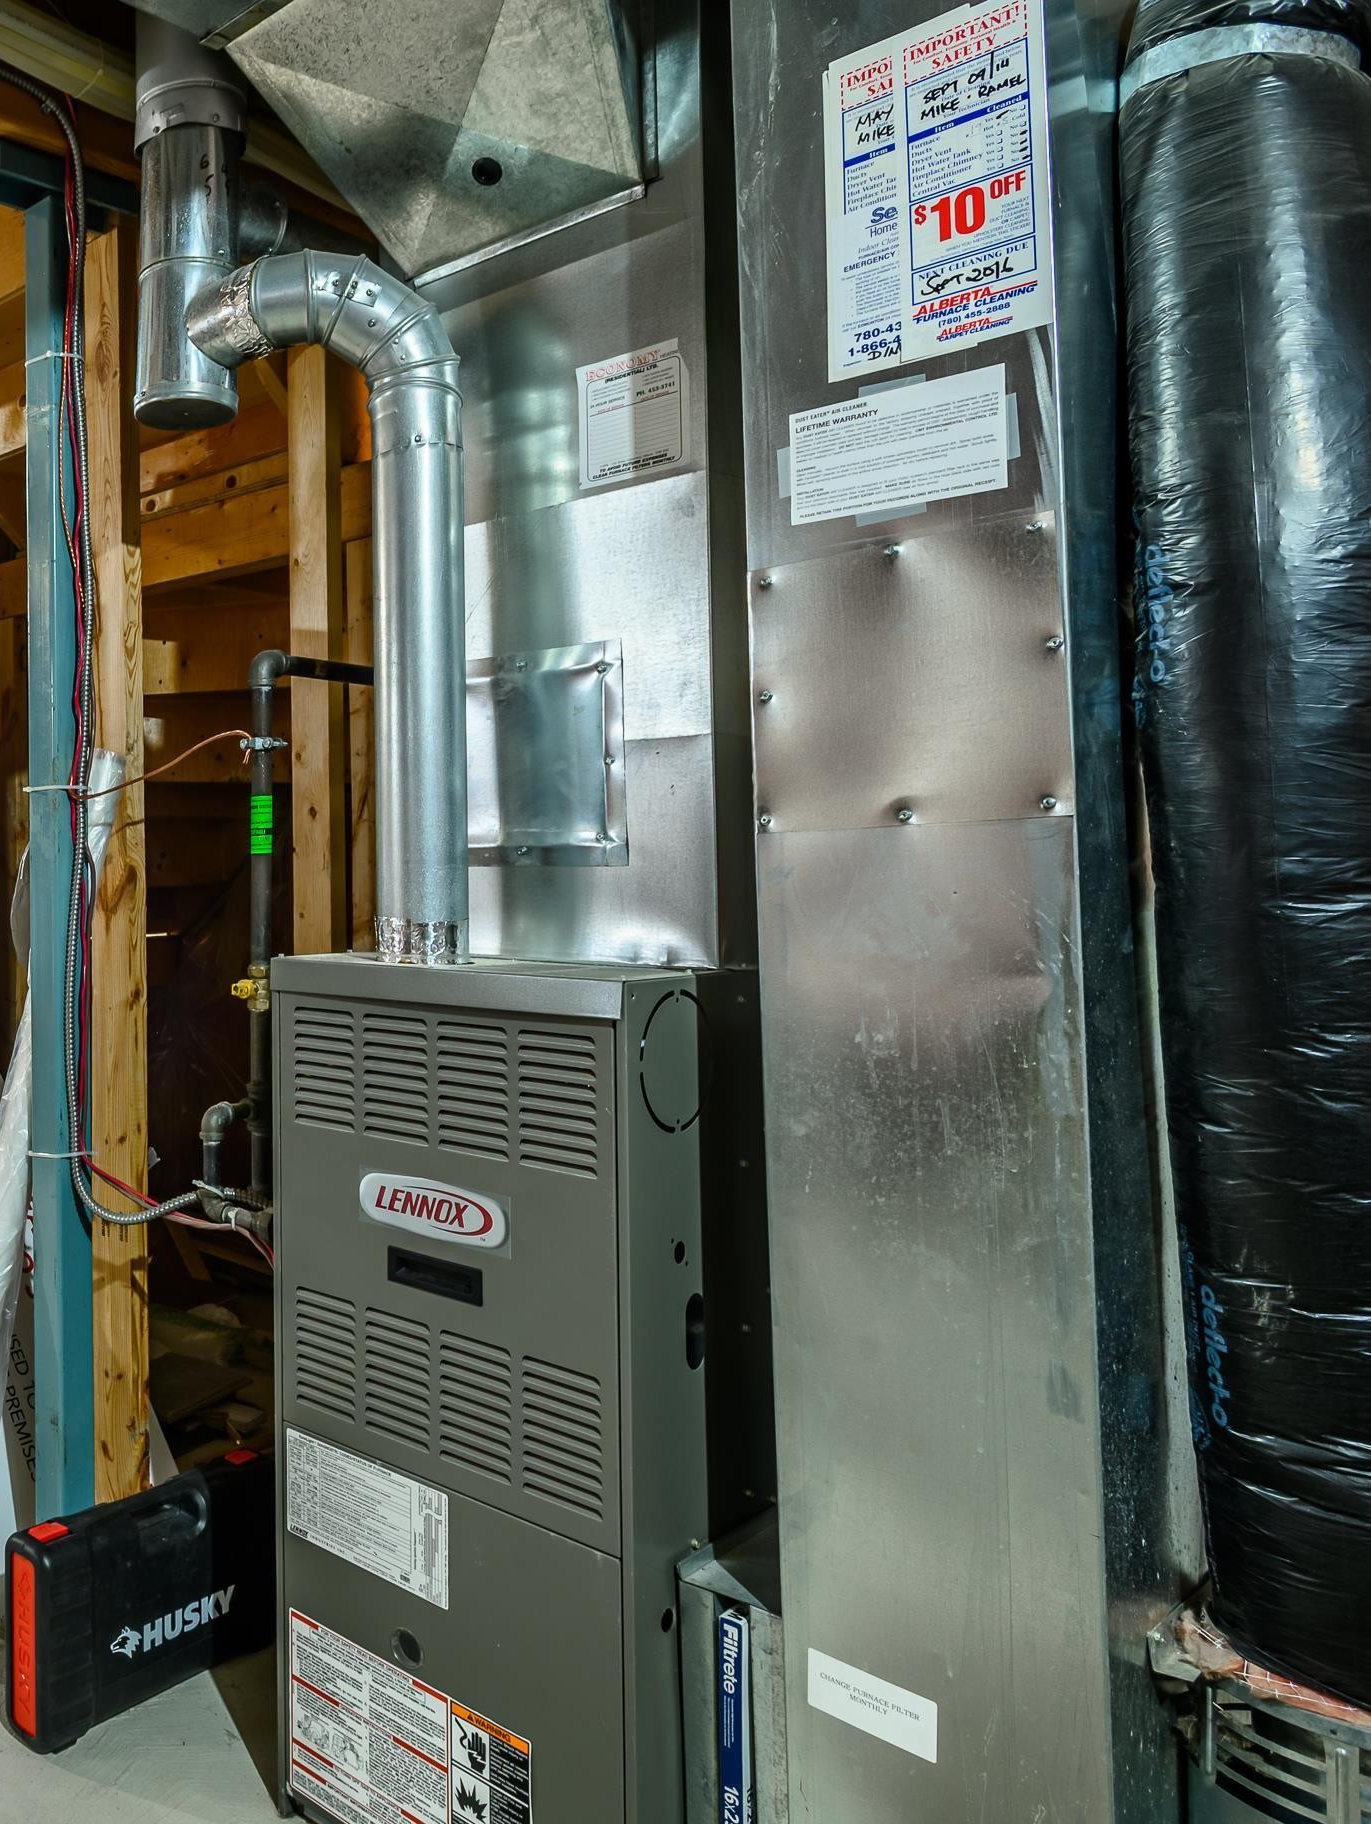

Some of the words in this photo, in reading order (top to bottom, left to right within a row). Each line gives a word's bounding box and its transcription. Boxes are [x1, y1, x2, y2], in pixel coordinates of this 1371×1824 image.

[910, 5, 1019, 61] IMPORTANT!
[931, 33, 997, 69] SAFETY
[923, 80, 959, 104] SEPT
[855, 103, 894, 132] MAY
[920, 97, 960, 120] MIKE
[934, 122, 955, 133] Item
[986, 94, 1022, 113] Cleaned
[857, 124, 895, 145] MIKE
[911, 135, 941, 151] Furnace
[869, 148, 888, 159] Item
[911, 147, 932, 159] Ducts
[911, 154, 934, 167] Dryer
[935, 147, 952, 157] Vent
[911, 164, 926, 175] Hot
[927, 156, 950, 171] Water
[952, 148, 971, 160] Tank
[847, 161, 875, 175] Furnace
[912, 168, 946, 183] Fireplace
[947, 153, 984, 172] Chimney
[912, 181, 924, 190] Air
[925, 165, 972, 186] Conditioner
[847, 180, 867, 190] Dryer
[869, 172, 885, 182] Vent
[847, 189, 861, 198] Hot
[862, 182, 883, 192] Water
[912, 184, 941, 198] Central
[941, 178, 956, 188] Vac
[847, 191, 879, 206] Fireplace
[847, 205, 859, 213] Air
[914, 186, 986, 243] $10
[990, 170, 1026, 200] OFF
[870, 222, 898, 238] Home
[843, 250, 896, 273] EMERGENCY
[948, 250, 1002, 272] CLEANING
[1006, 241, 1029, 255] DUE
[913, 286, 993, 317] ALBERTA
[913, 302, 970, 324] FURNACE
[974, 284, 1038, 307] CLEANING
[938, 315, 962, 328] (780)
[964, 301, 1011, 319] 455-2888
[939, 317, 992, 337] ALBERTA
[937, 330, 968, 342] CARPET
[970, 317, 1014, 334] CLEANING
[586, 349, 660, 381] ECONOMY
[795, 415, 809, 424] DUST
[831, 407, 841, 416] AIR
[842, 401, 868, 413] CLEANER
[795, 419, 831, 434] LIFETIME
[832, 408, 879, 426] WARRANTY
[375, 1186, 469, 1228] LENNOX
[290, 1524, 309, 1538] LENNOX
[143, 1584, 236, 1653] HUSKY
[723, 1623, 739, 1694] Filtrete
[820, 1672, 851, 1690] CHANGE
[853, 1687, 890, 1708] FURNACE
[891, 1703, 920, 1722] FILTER
[849, 1693, 888, 1716] MONTHLY
[474, 1717, 511, 1742] WARNING
